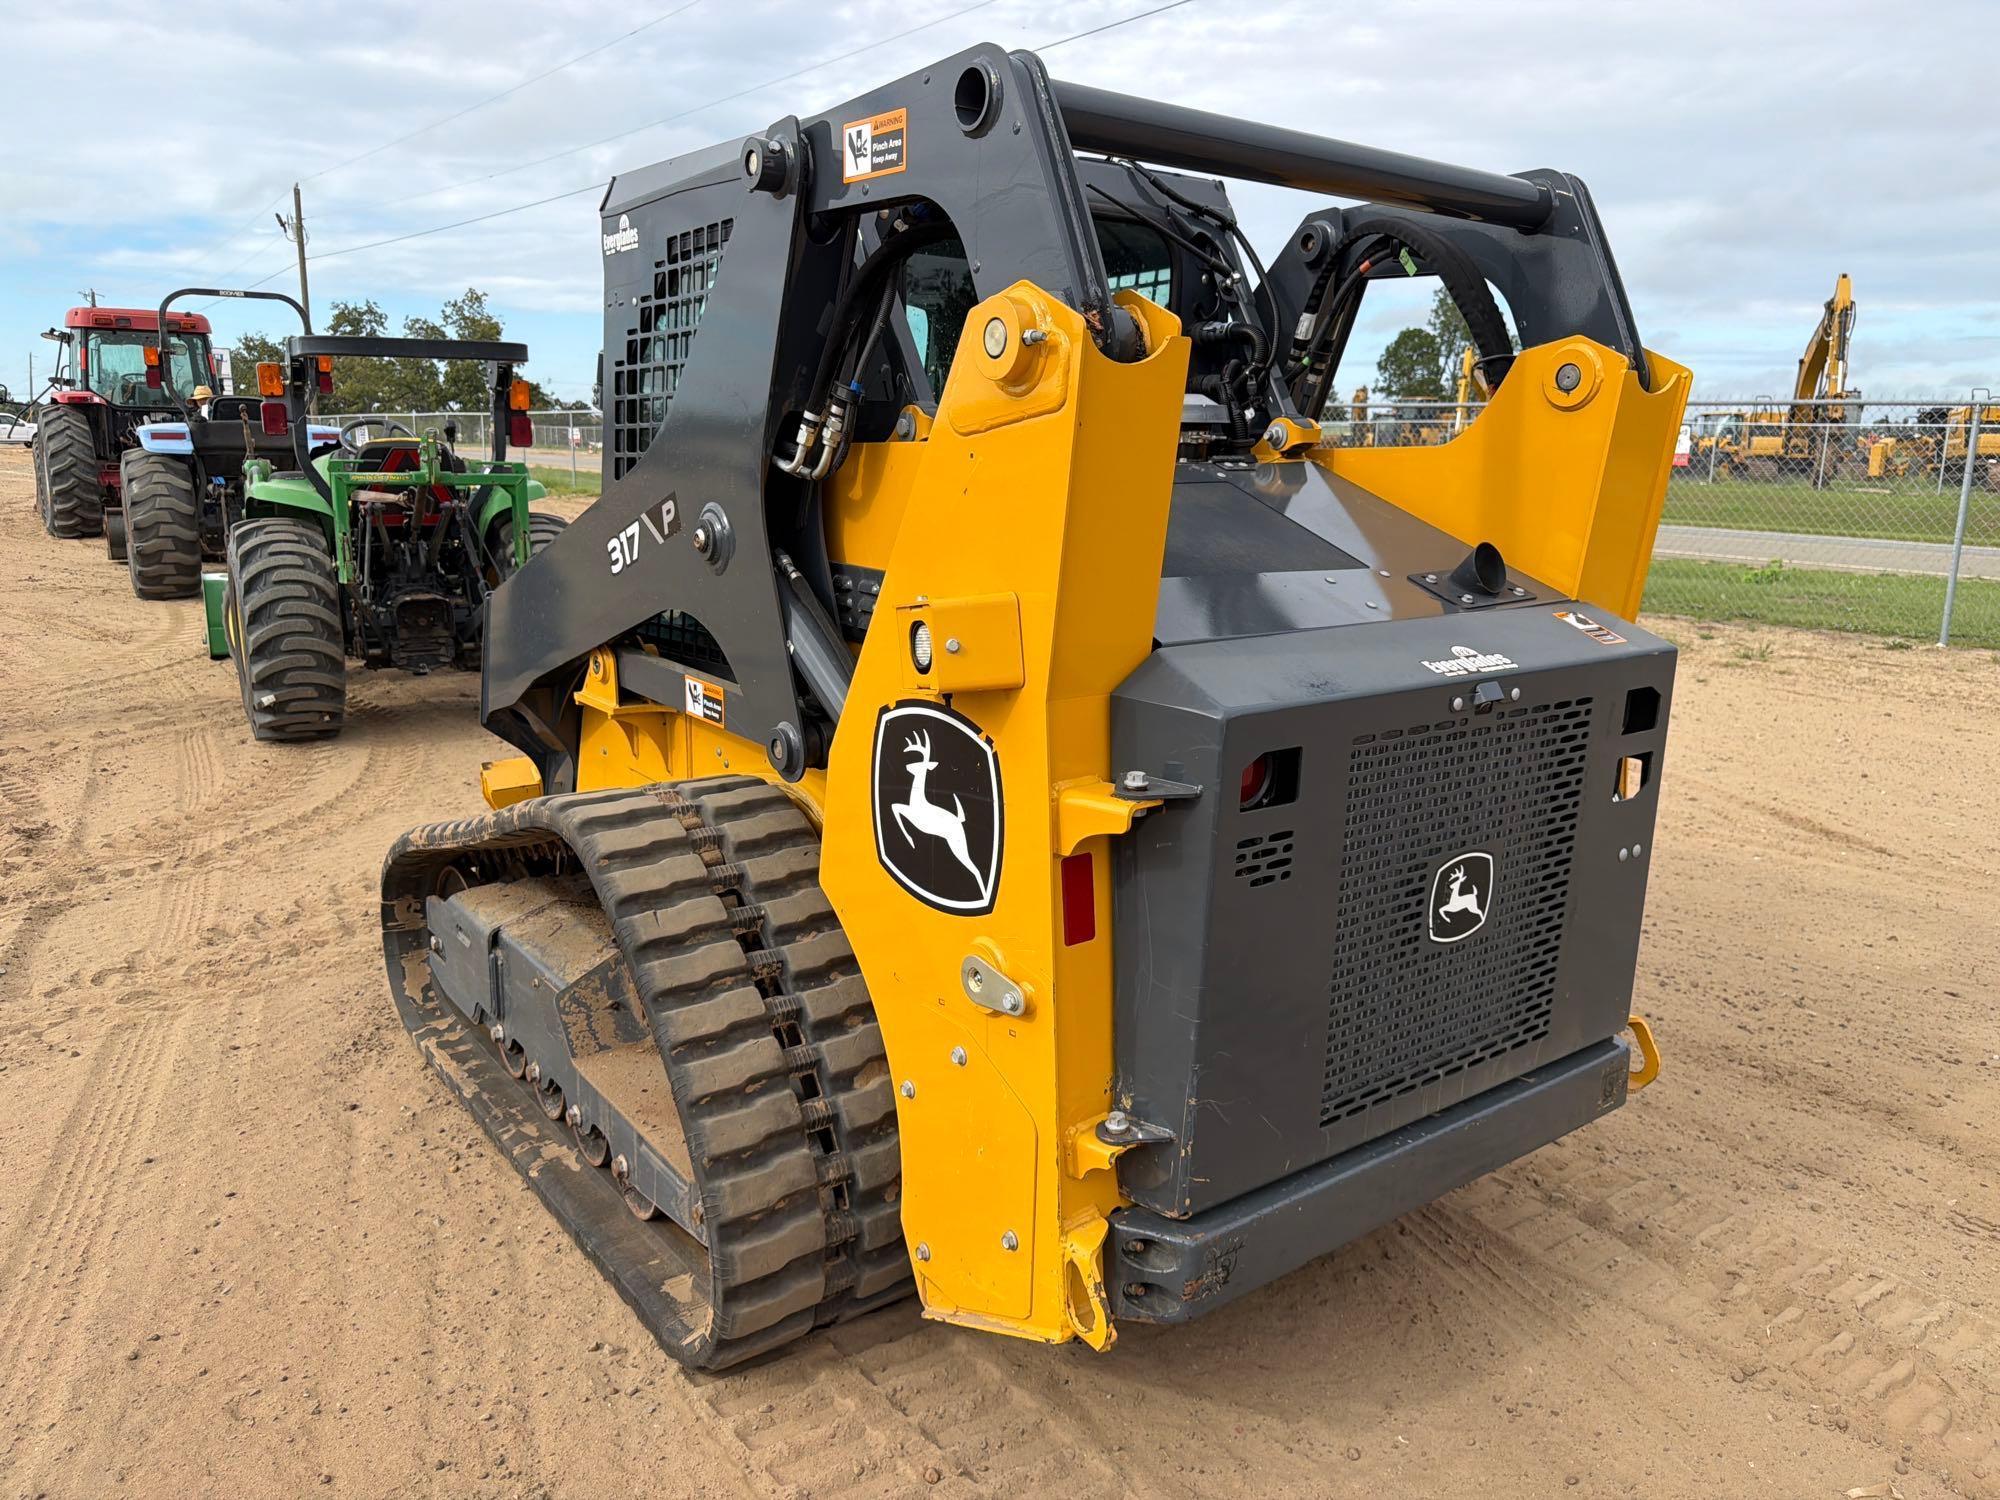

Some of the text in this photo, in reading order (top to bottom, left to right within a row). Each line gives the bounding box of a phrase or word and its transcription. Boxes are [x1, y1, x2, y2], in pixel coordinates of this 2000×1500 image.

[878, 115, 903, 128] WARNING
[872, 138, 902, 152] Pinch Area
[872, 152, 898, 165] Keep Away
[603, 227, 639, 251] Everglades
[607, 499, 676, 574] 317 P
[1420, 653, 1513, 673] Everglades
